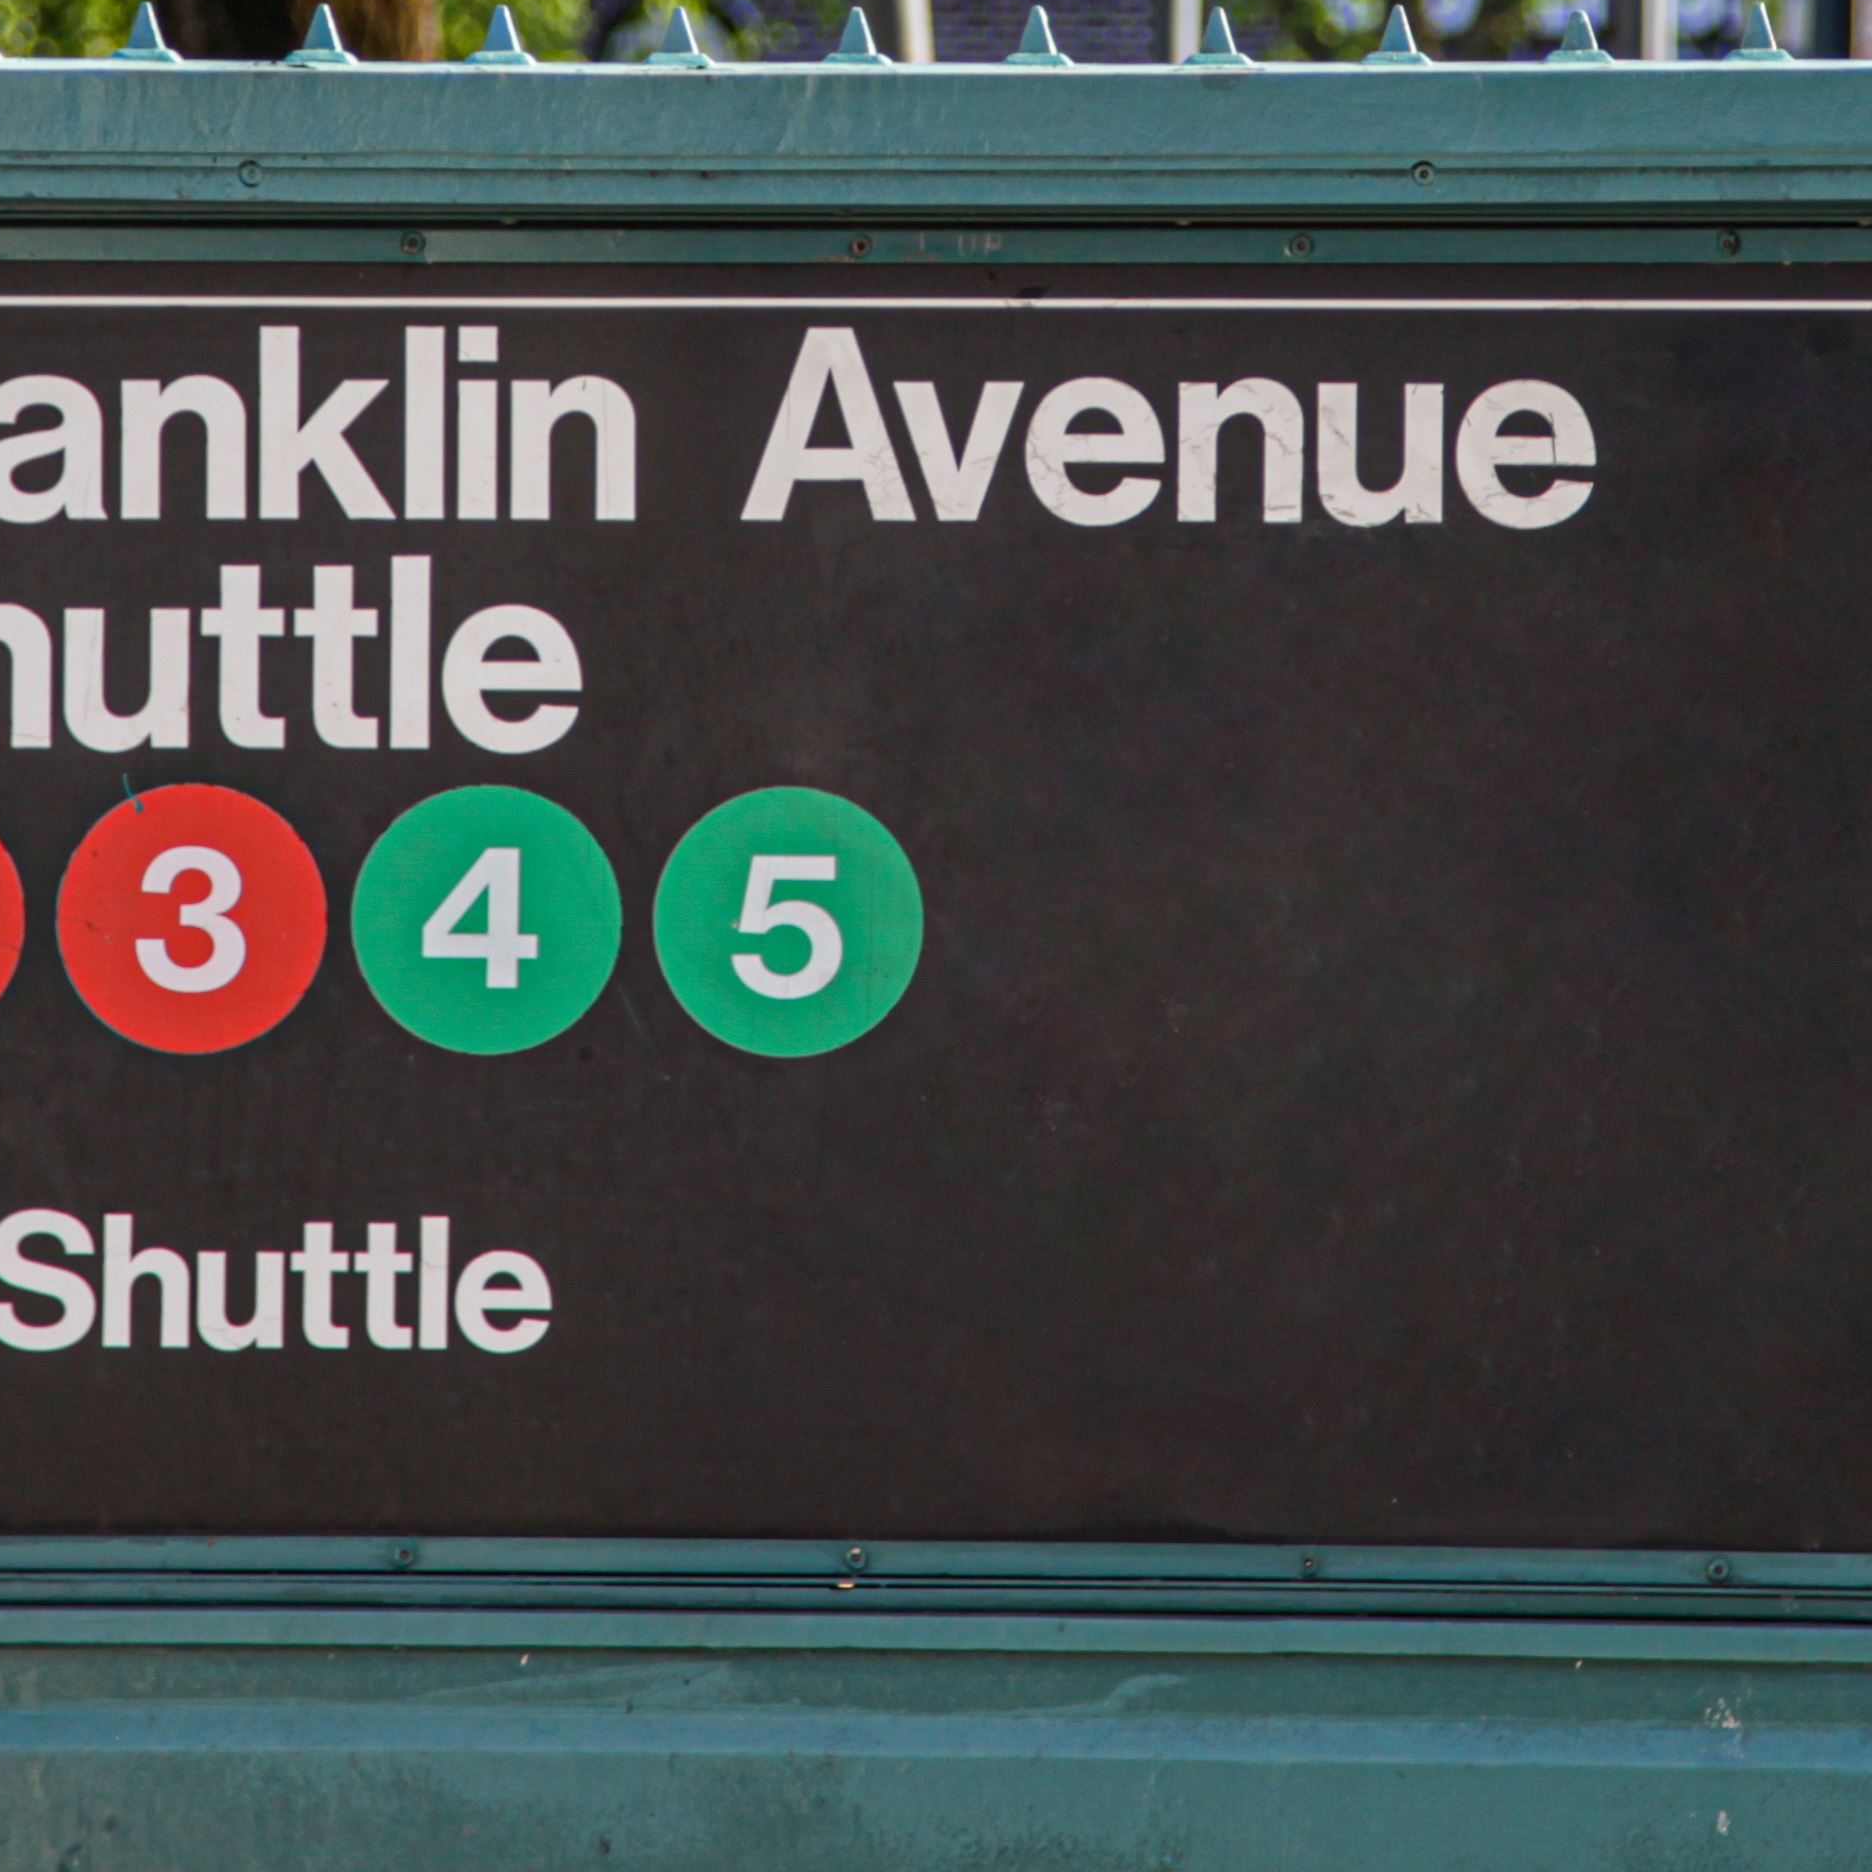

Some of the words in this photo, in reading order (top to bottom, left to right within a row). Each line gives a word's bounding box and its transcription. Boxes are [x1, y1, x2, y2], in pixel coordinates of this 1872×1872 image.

[740, 327, 1598, 530] Avenue
[135, 845, 246, 993] 3
[422, 846, 539, 989] 4
[731, 854, 843, 999] 5
